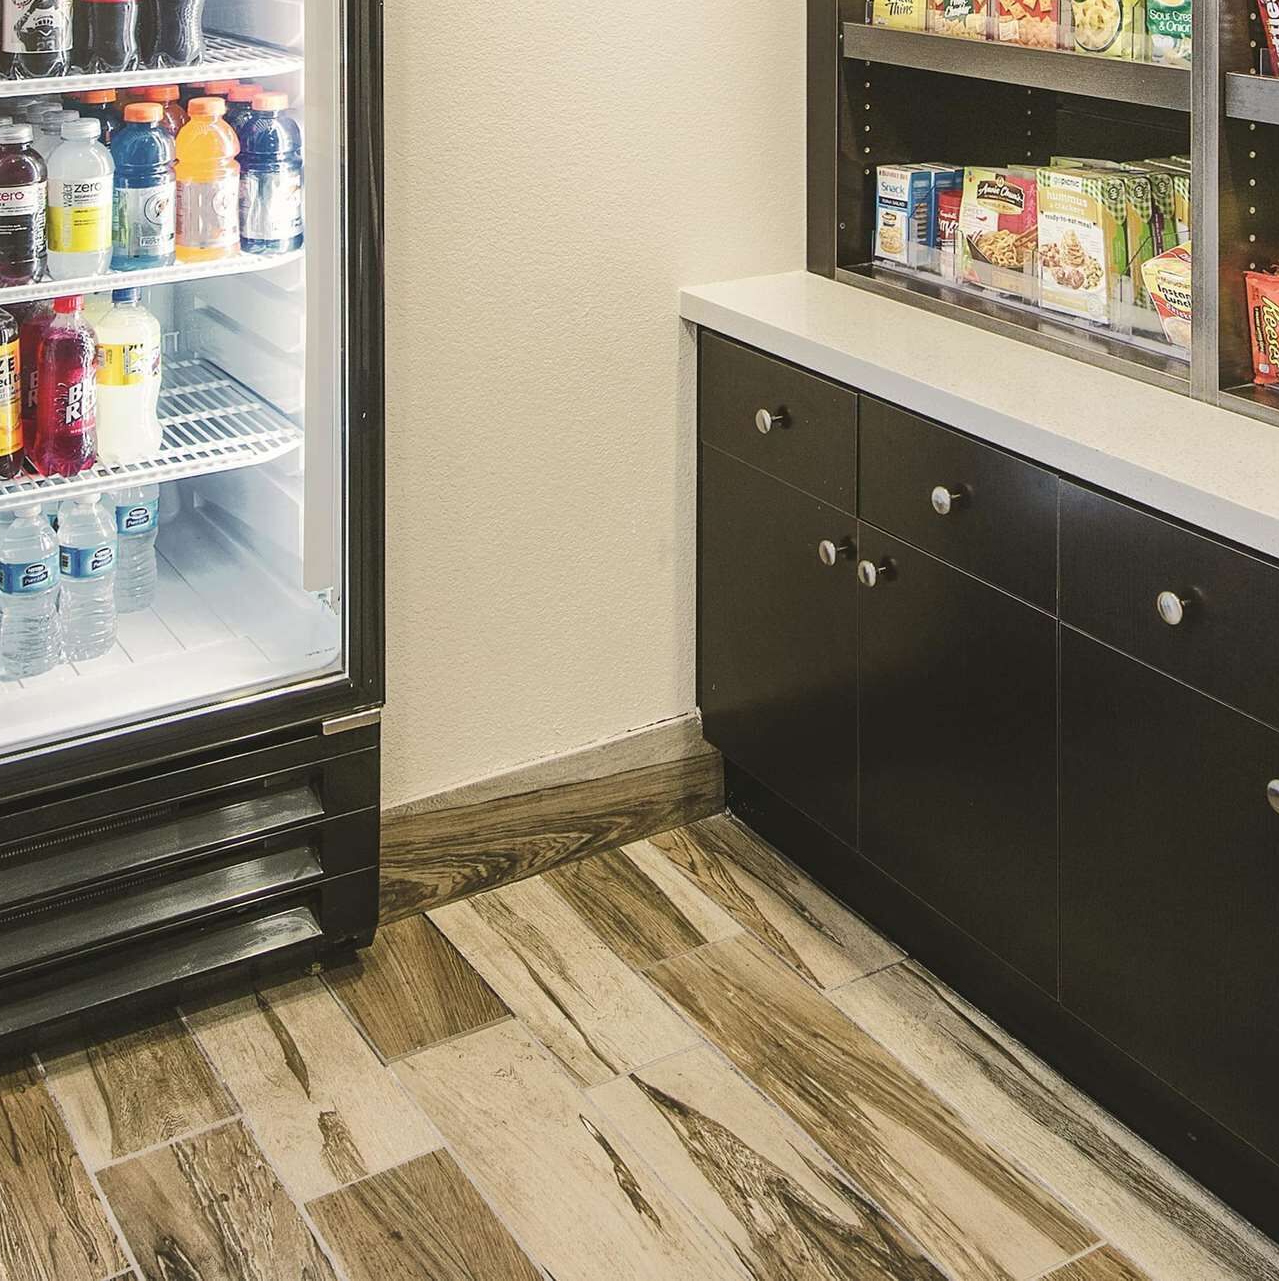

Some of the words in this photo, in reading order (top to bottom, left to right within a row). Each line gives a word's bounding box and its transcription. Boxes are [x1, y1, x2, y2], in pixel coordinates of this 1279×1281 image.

[887, 1, 914, 17] Thins
[1149, 9, 1171, 22] Sour
[1158, 22, 1167, 32] &
[74, 183, 102, 194] zero
[880, 182, 905, 194] Snack
[1045, 191, 1089, 208] hummus
